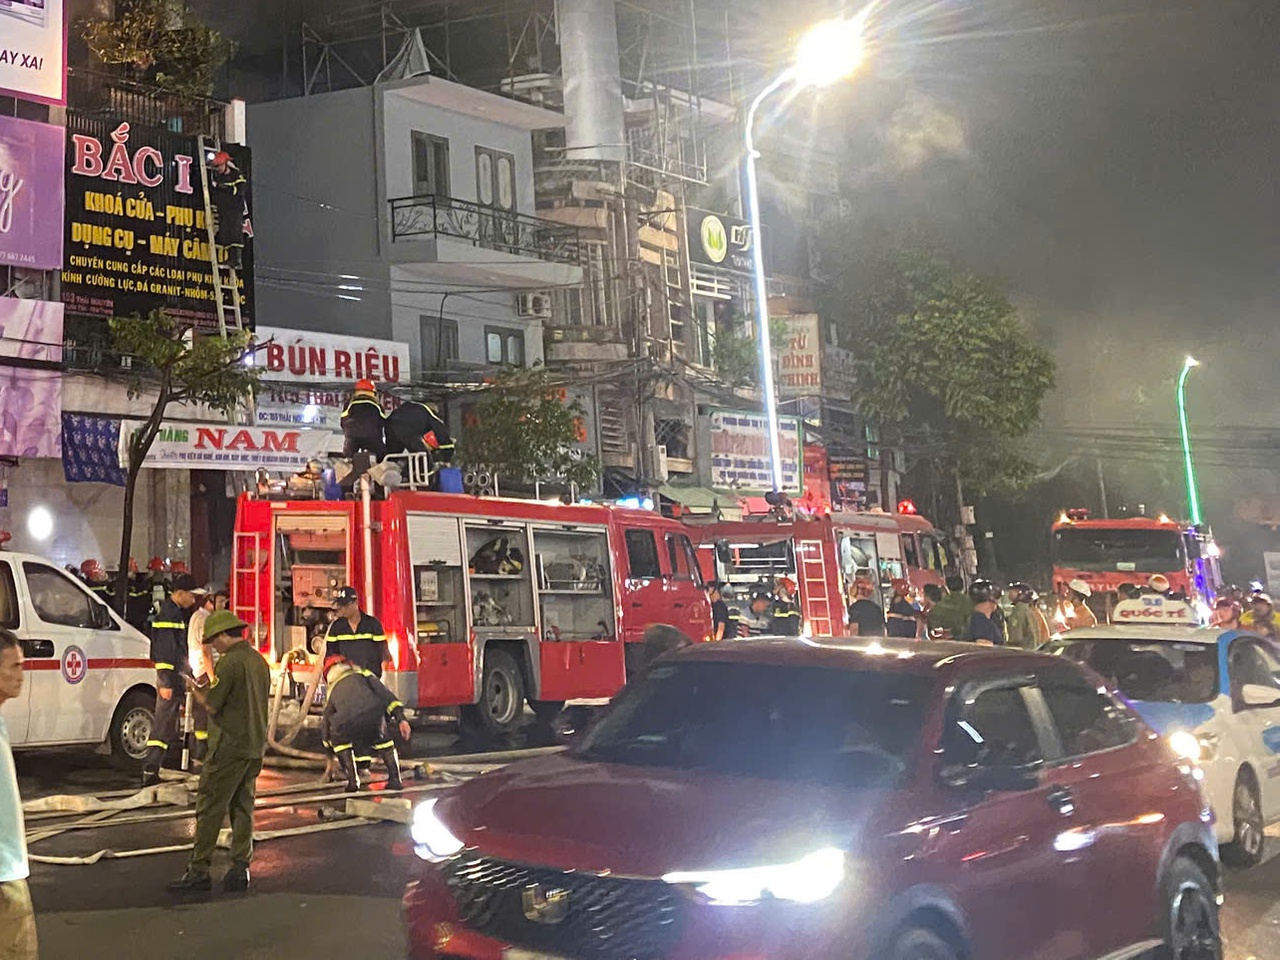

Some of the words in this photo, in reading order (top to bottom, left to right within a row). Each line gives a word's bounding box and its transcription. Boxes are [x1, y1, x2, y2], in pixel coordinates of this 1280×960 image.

[21, 53, 44, 71] XA!
[73, 122, 164, 187] BẮC
[84, 190, 124, 217] KHOÁ
[125, 191, 154, 221] CỬA
[166, 205, 194, 233] PHỤ
[71, 222, 113, 250] DỤNG
[113, 228, 135, 256] CỤ
[149, 231, 180, 258] MÁY
[61, 271, 82, 282] KÍNH
[85, 272, 115, 288] CƯỜNG
[69, 254, 104, 269] CHUYÊN
[106, 259, 129, 273] CUNG
[131, 260, 148, 276] CẤP
[149, 263, 166, 278] CÁC
[166, 270, 185, 282] LOẠI
[186, 271, 202, 285] PHỤ
[266, 338, 327, 377] BÚN
[334, 347, 401, 384] RIÊU
[193, 427, 302, 454] NAM
[1120, 606, 1162, 618] QUỐC
[1167, 606, 1186, 618] TẾ
